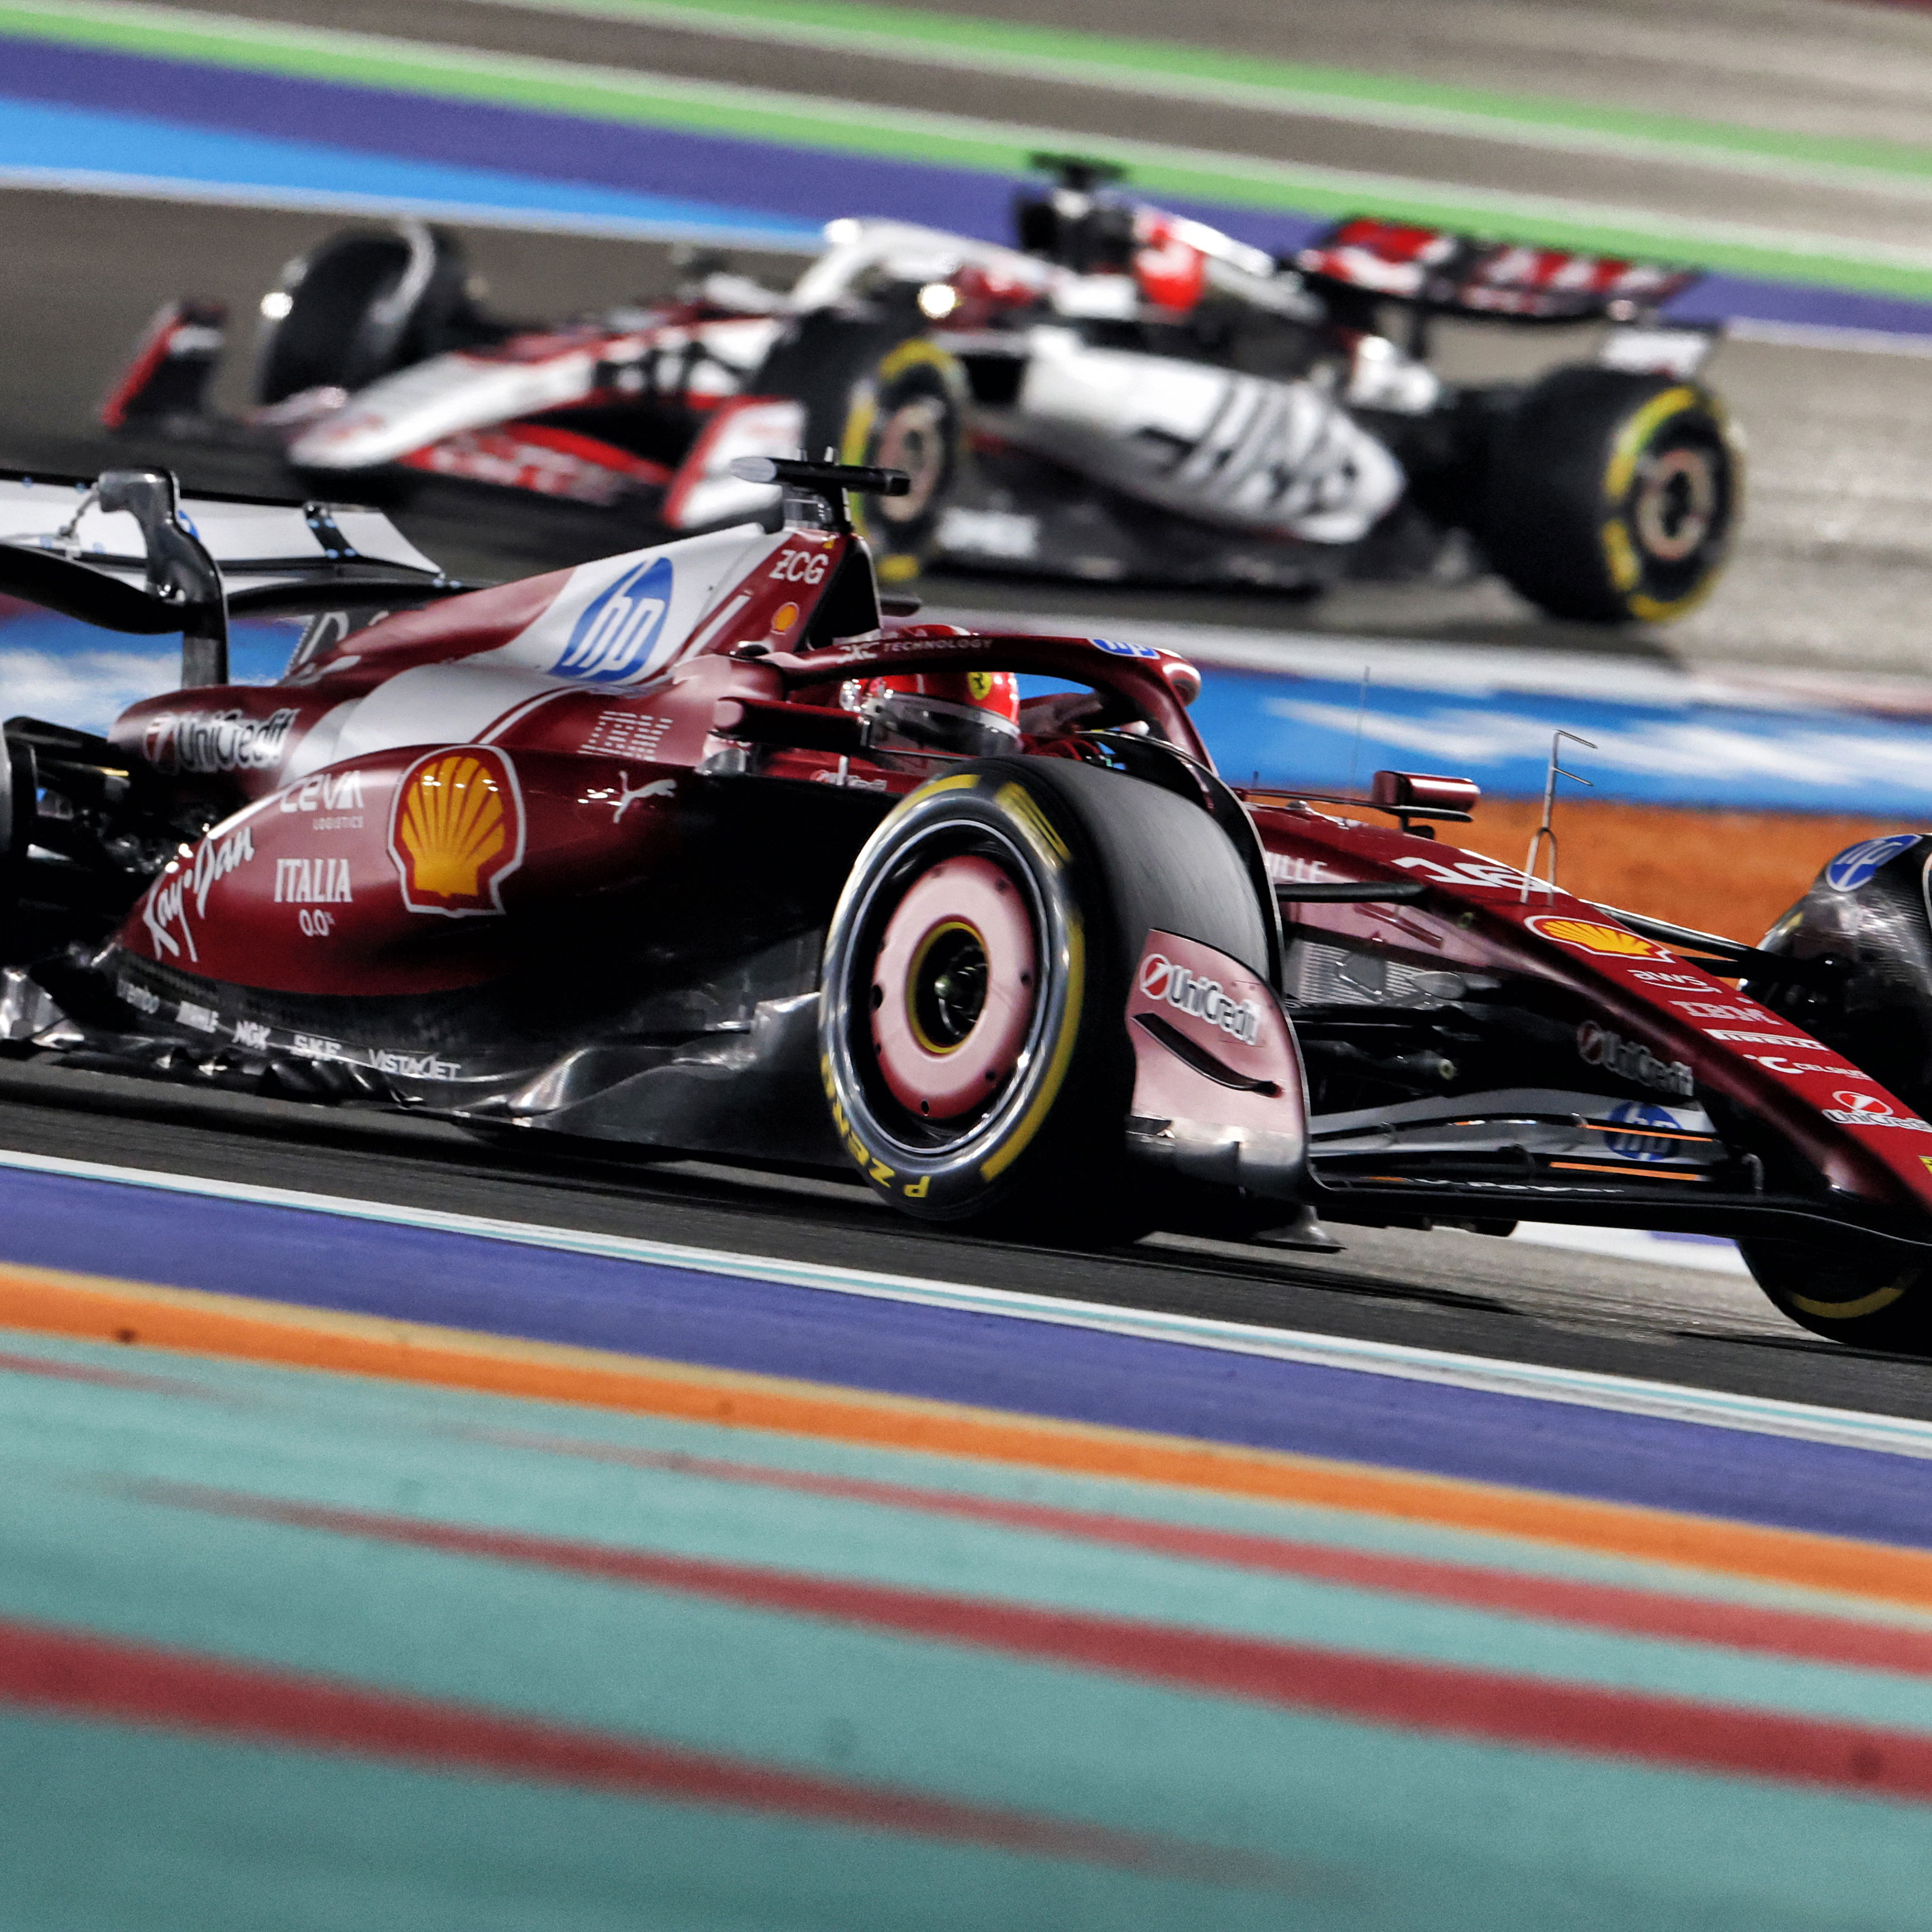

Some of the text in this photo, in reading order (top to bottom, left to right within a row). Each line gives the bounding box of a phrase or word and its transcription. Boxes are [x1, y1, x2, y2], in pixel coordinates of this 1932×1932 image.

[769, 549, 829, 584] ZCG
[559, 559, 667, 679] hp
[883, 639, 993, 652] TECHNOLOGY
[577, 710, 674, 762] IBM
[274, 858, 353, 903] ITALIA
[1391, 856, 1554, 893] 16
[1668, 1000, 1785, 1025] IBM
